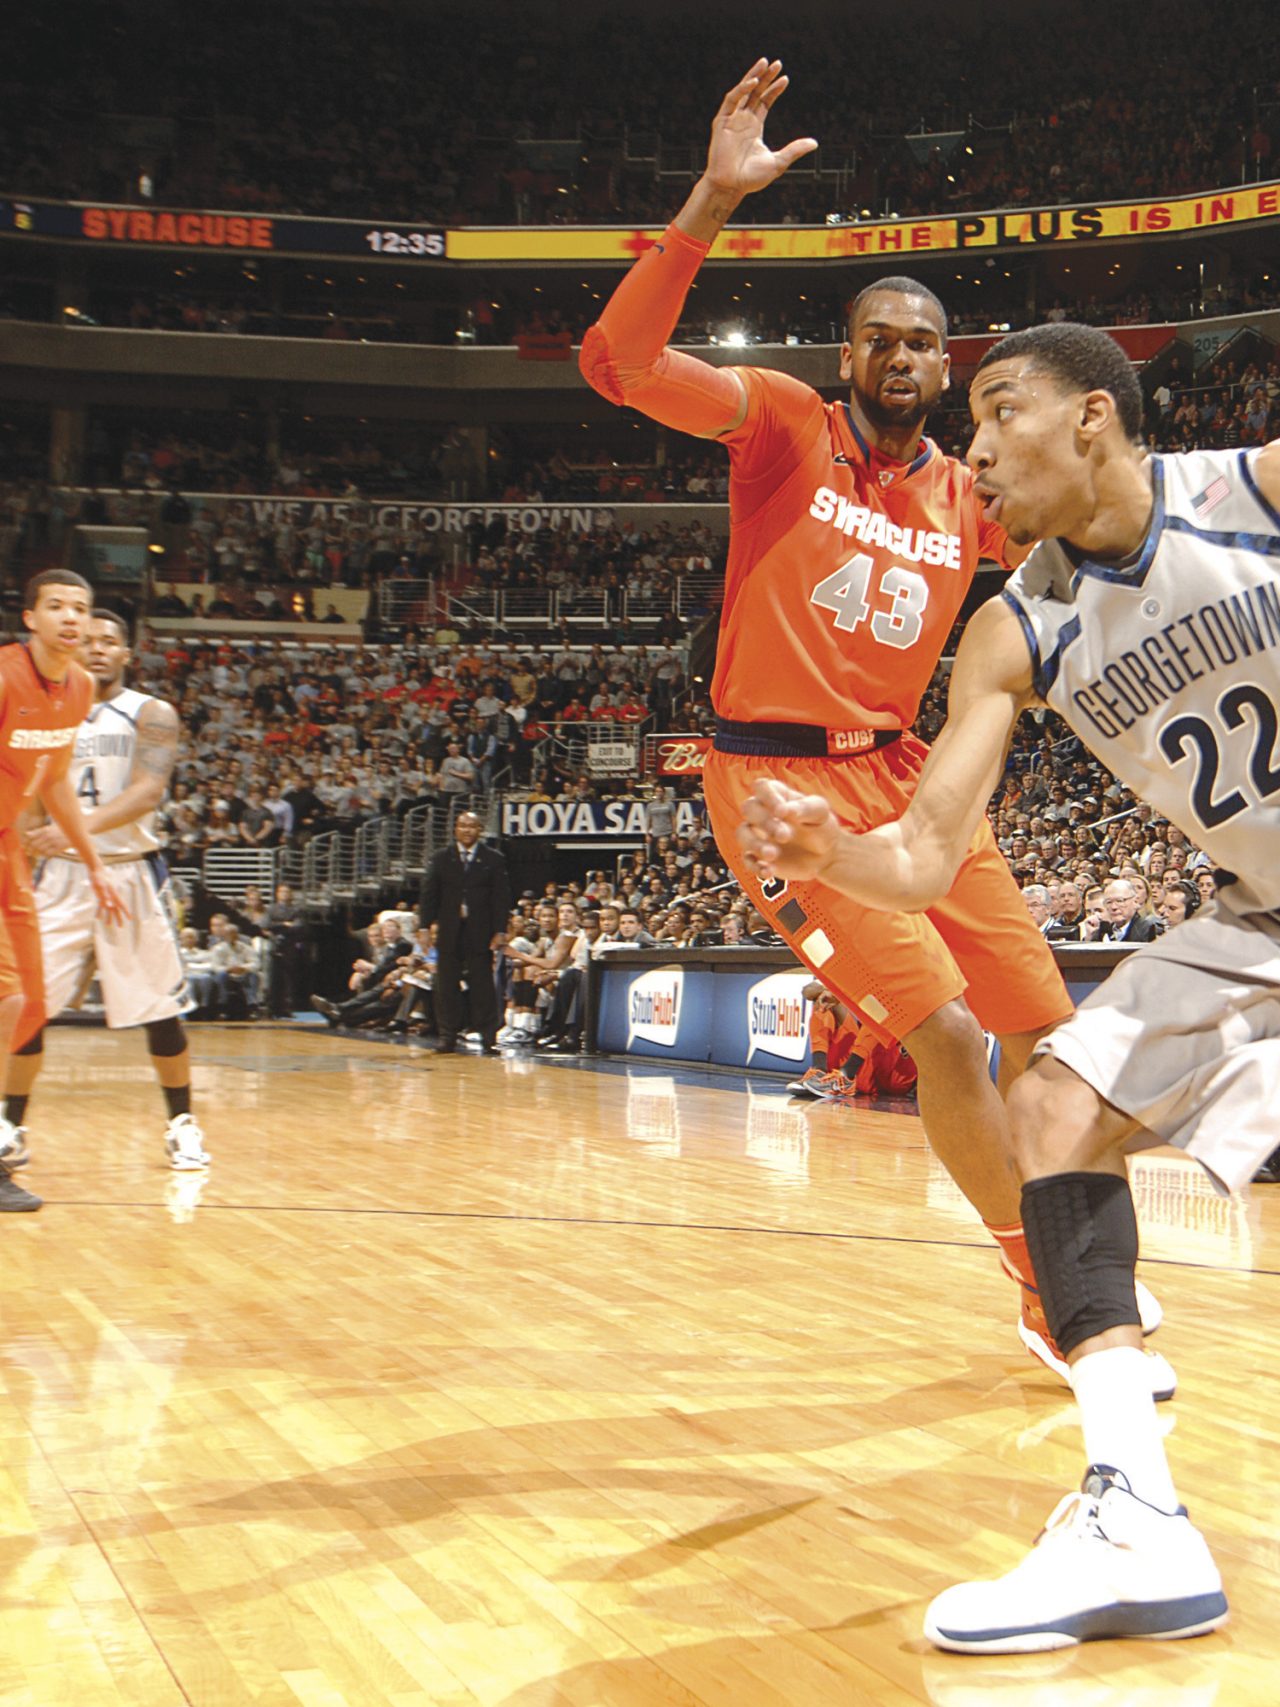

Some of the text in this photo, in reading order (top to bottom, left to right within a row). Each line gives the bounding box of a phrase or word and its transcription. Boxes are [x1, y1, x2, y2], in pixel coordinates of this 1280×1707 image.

[82, 207, 274, 248] SYRACUSE
[365, 230, 445, 256] 12:35
[852, 226, 932, 252] THE
[957, 208, 1103, 247] PLUS
[1129, 206, 1172, 232] IS
[1195, 197, 1234, 225] IN
[809, 486, 961, 570] SYRACUSE
[810, 552, 930, 651] 43
[657, 742, 707, 772] Bu
[77, 765, 99, 806] 4
[503, 802, 697, 834] HOYA SAA
[631, 982, 678, 1026] StubHub!
[752, 988, 810, 1038] StubHub!
